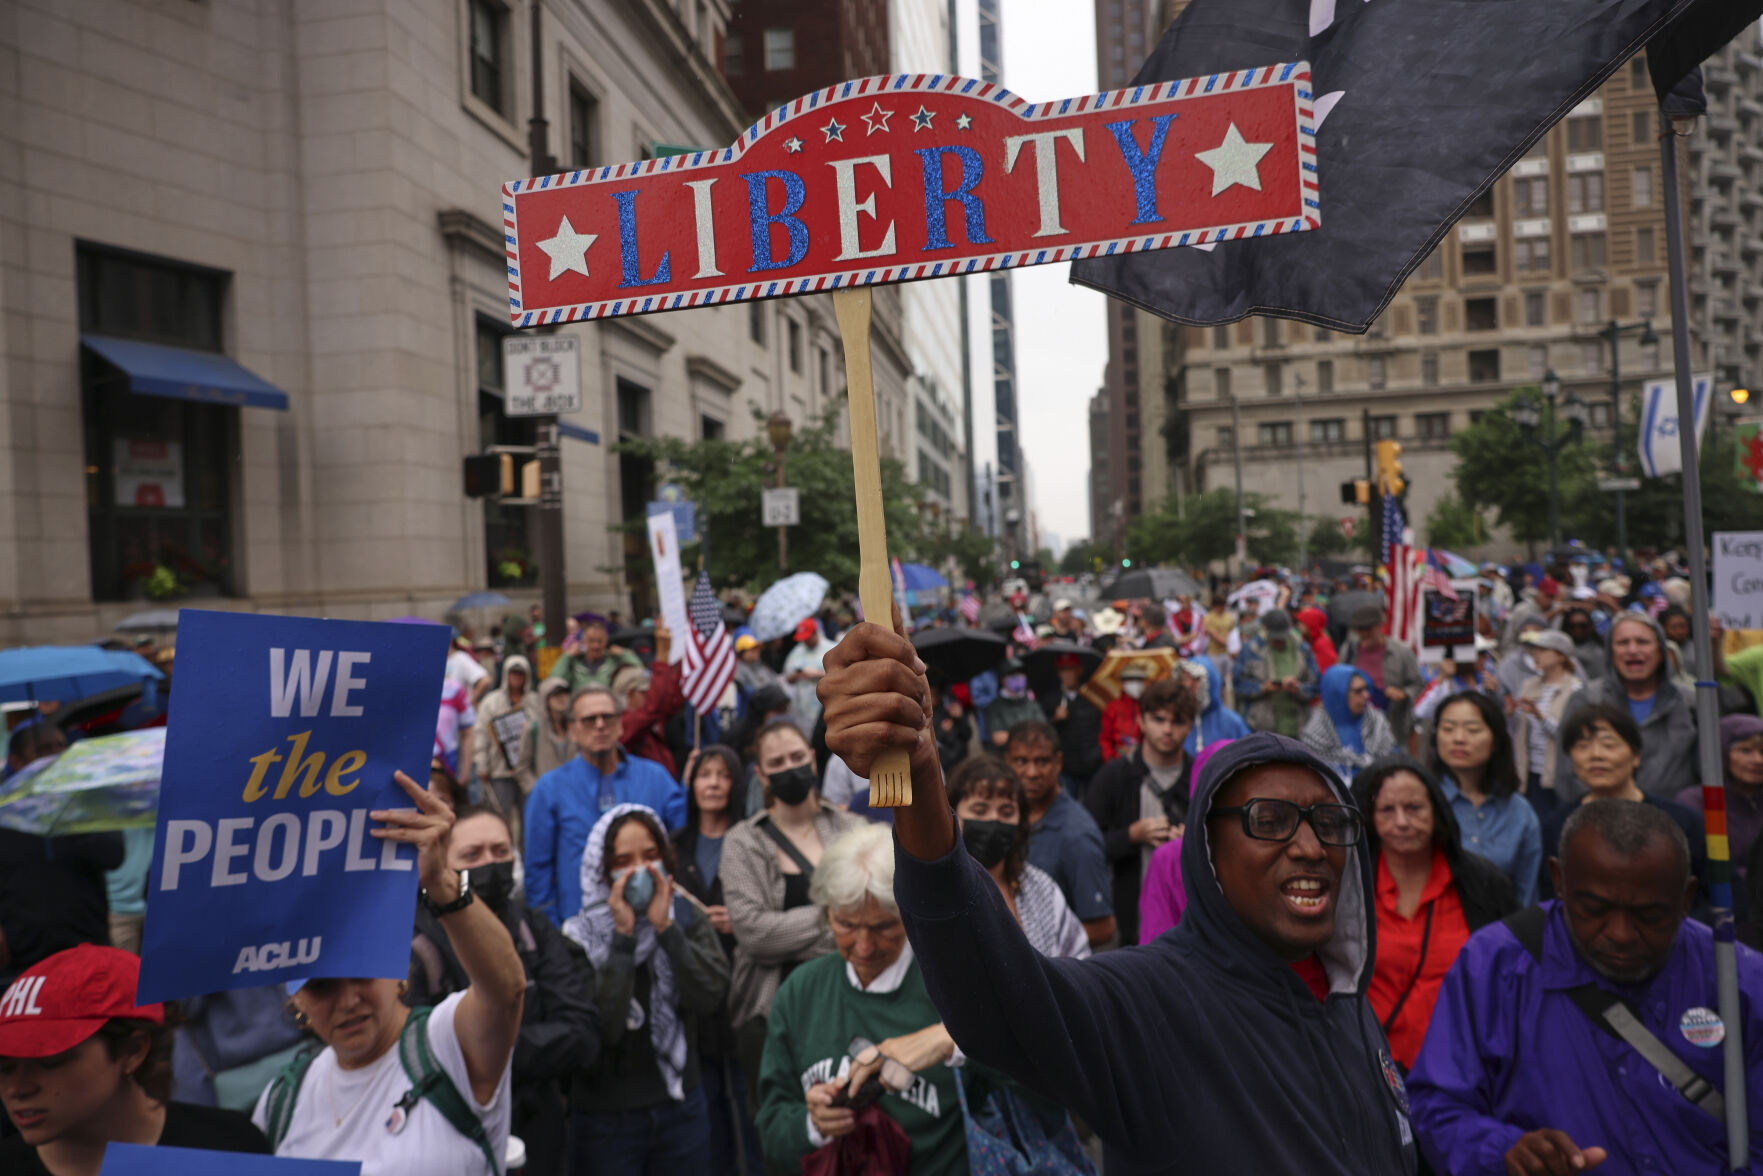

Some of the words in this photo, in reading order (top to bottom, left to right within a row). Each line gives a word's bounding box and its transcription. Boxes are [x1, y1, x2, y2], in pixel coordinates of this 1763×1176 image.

[610, 114, 1178, 289] LIBERTY
[510, 395, 536, 411] THE
[544, 394, 575, 410] BOX
[269, 648, 371, 718] WE
[242, 730, 367, 803] the
[160, 808, 417, 891] PEOPLE
[232, 936, 322, 974] ACLU
[0, 976, 46, 1018] PHL
